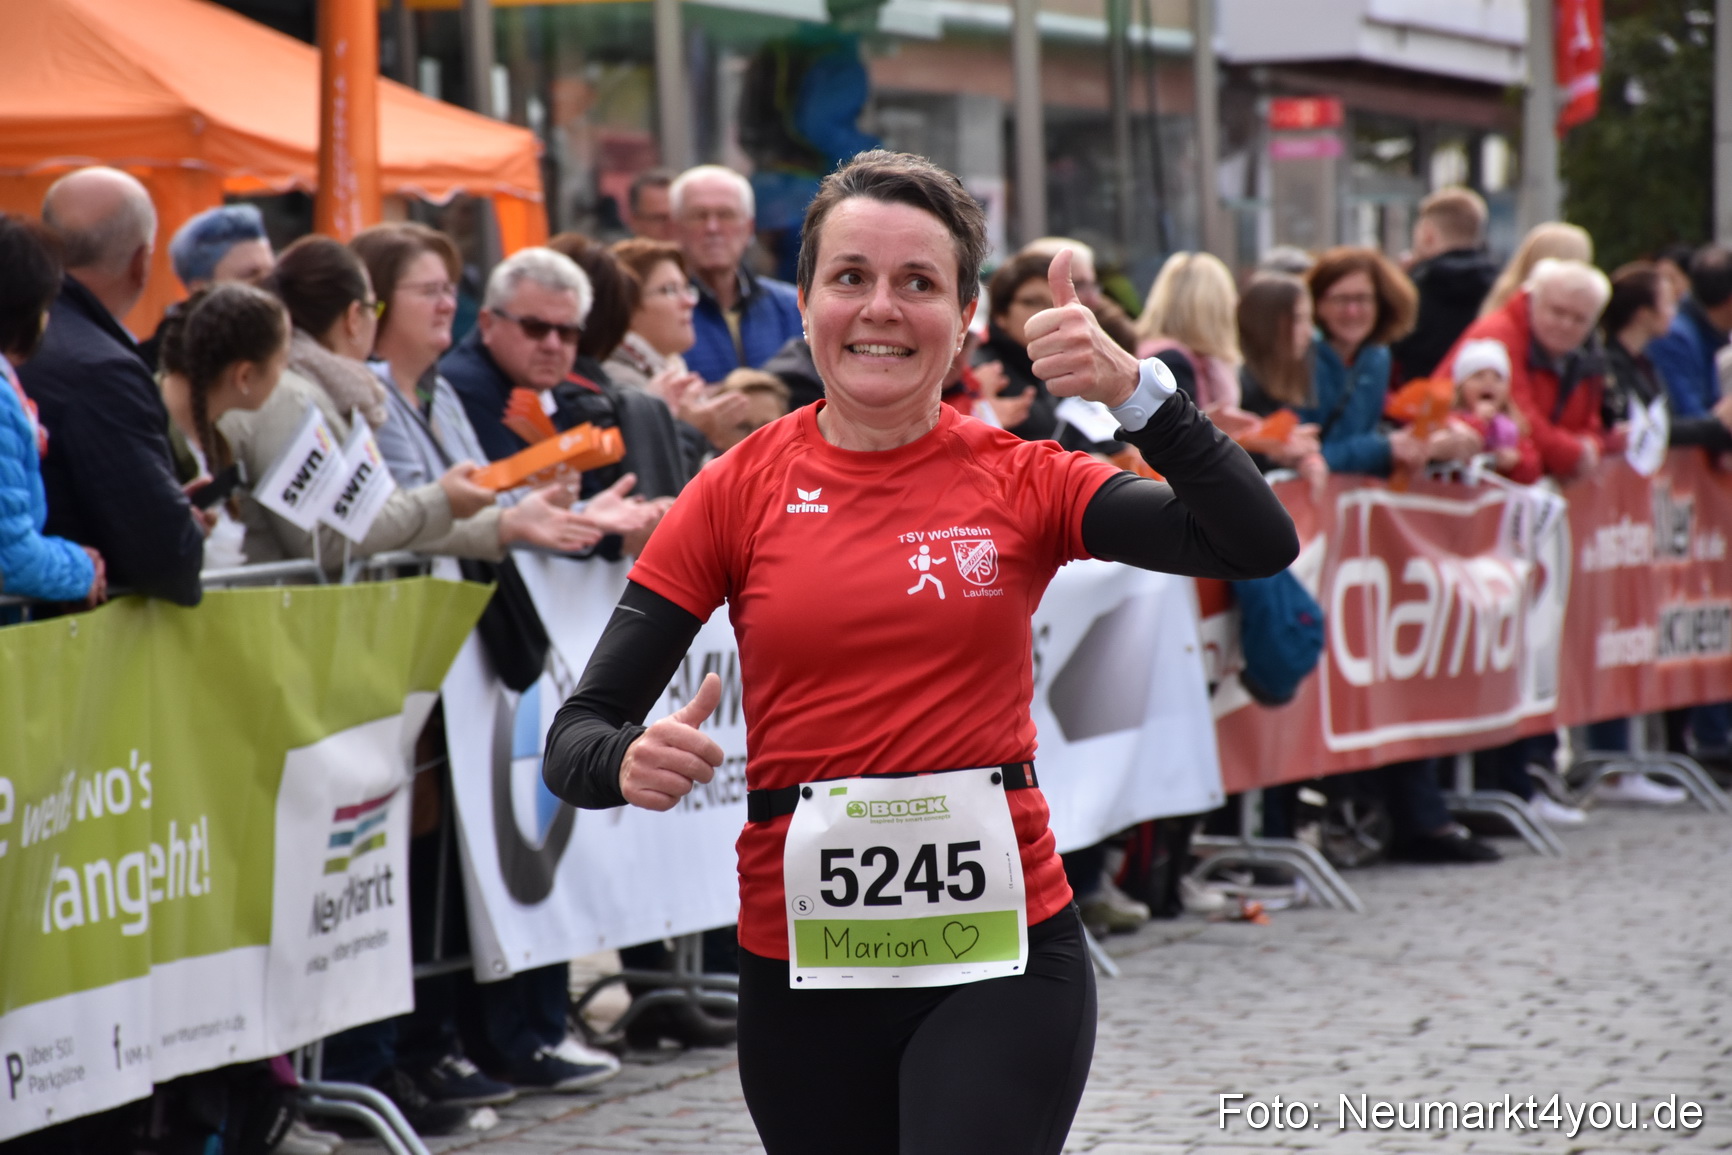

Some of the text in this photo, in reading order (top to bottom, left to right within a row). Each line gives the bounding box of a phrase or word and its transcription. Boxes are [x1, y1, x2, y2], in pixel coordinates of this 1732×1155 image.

[282, 449, 323, 508] swn
[333, 462, 371, 519] swn
[786, 502, 829, 514] erima
[898, 526, 991, 544] TSV Wolfstein
[963, 588, 1004, 598] Laufsport
[869, 795, 950, 817] BOCK
[820, 840, 986, 908] 5245
[799, 899, 807, 911] S
[823, 926, 929, 960] Marion
